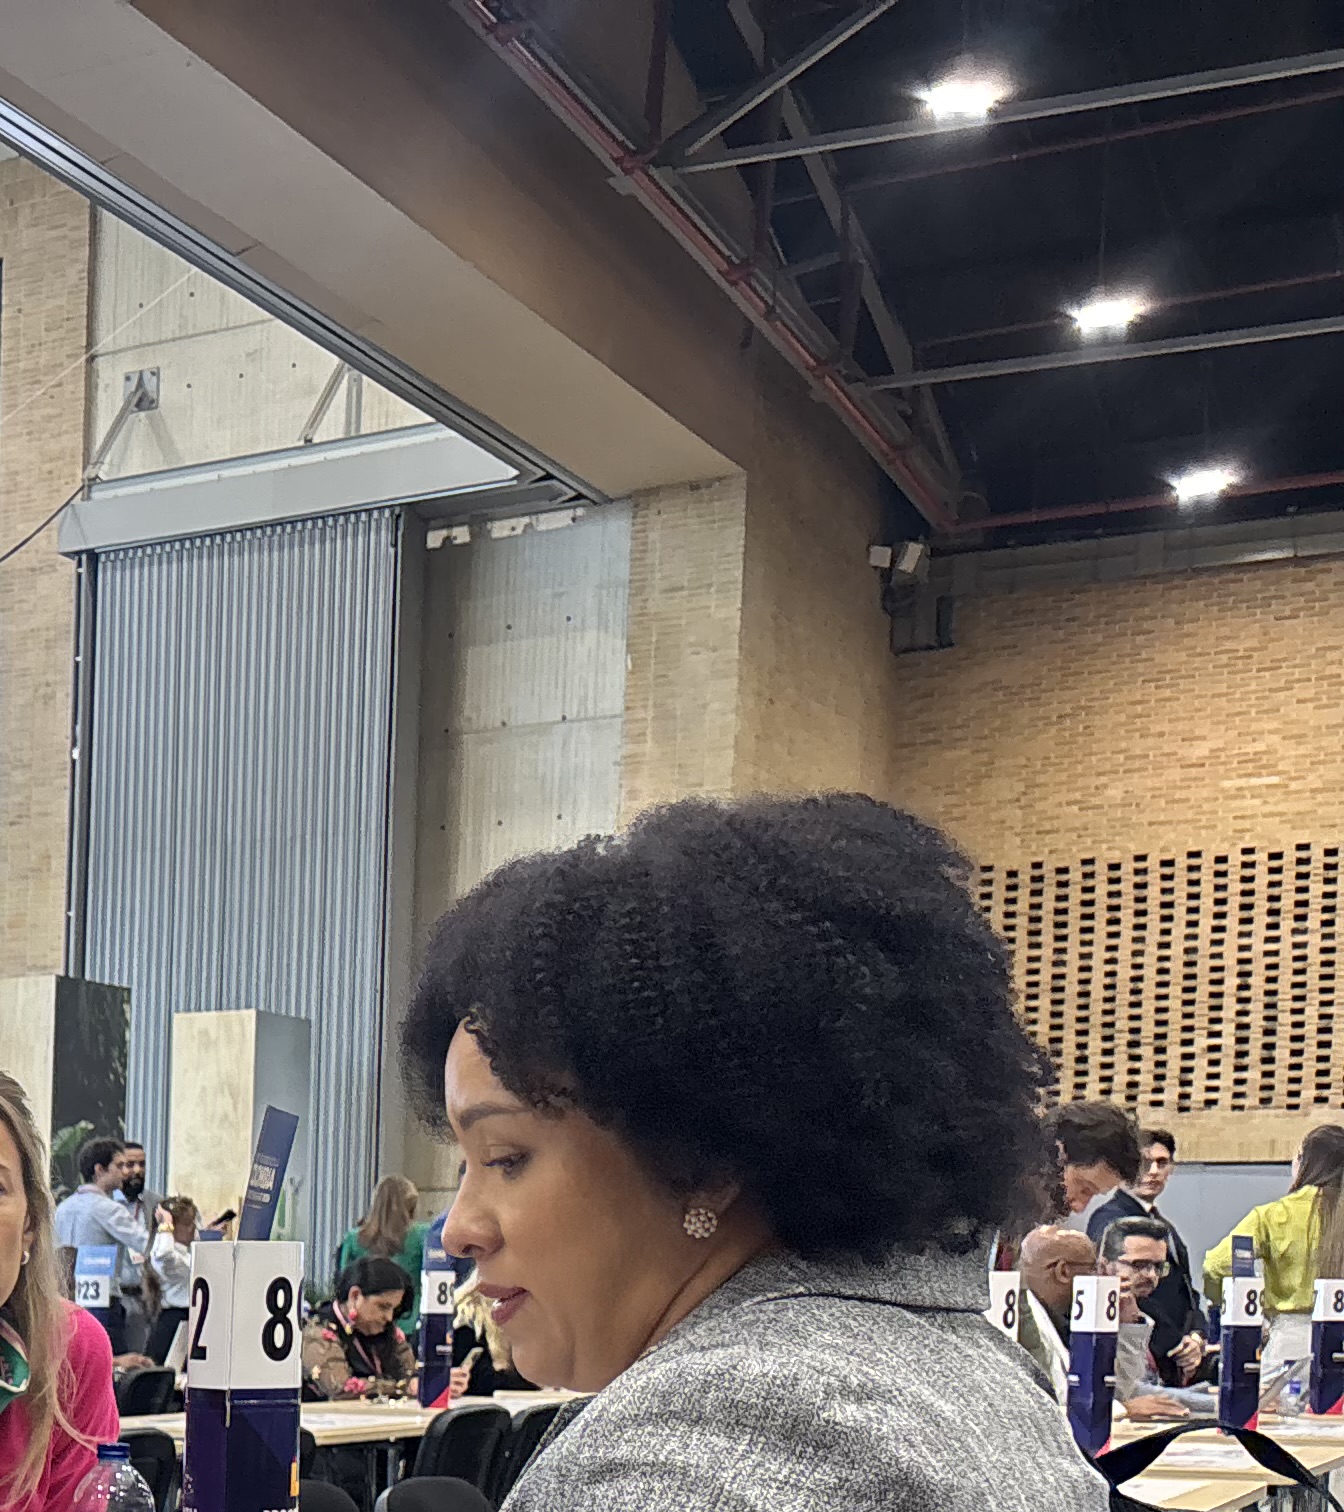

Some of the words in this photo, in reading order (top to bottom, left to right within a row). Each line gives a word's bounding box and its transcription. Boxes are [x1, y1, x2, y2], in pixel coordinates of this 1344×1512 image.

[190, 1276, 210, 1361] 2
[261, 1276, 302, 1362] 8
[1002, 1288, 1016, 1329] 8
[1073, 1290, 1085, 1320] 5
[1106, 1290, 1118, 1321] 8
[1333, 1289, 1344, 1313] 8
